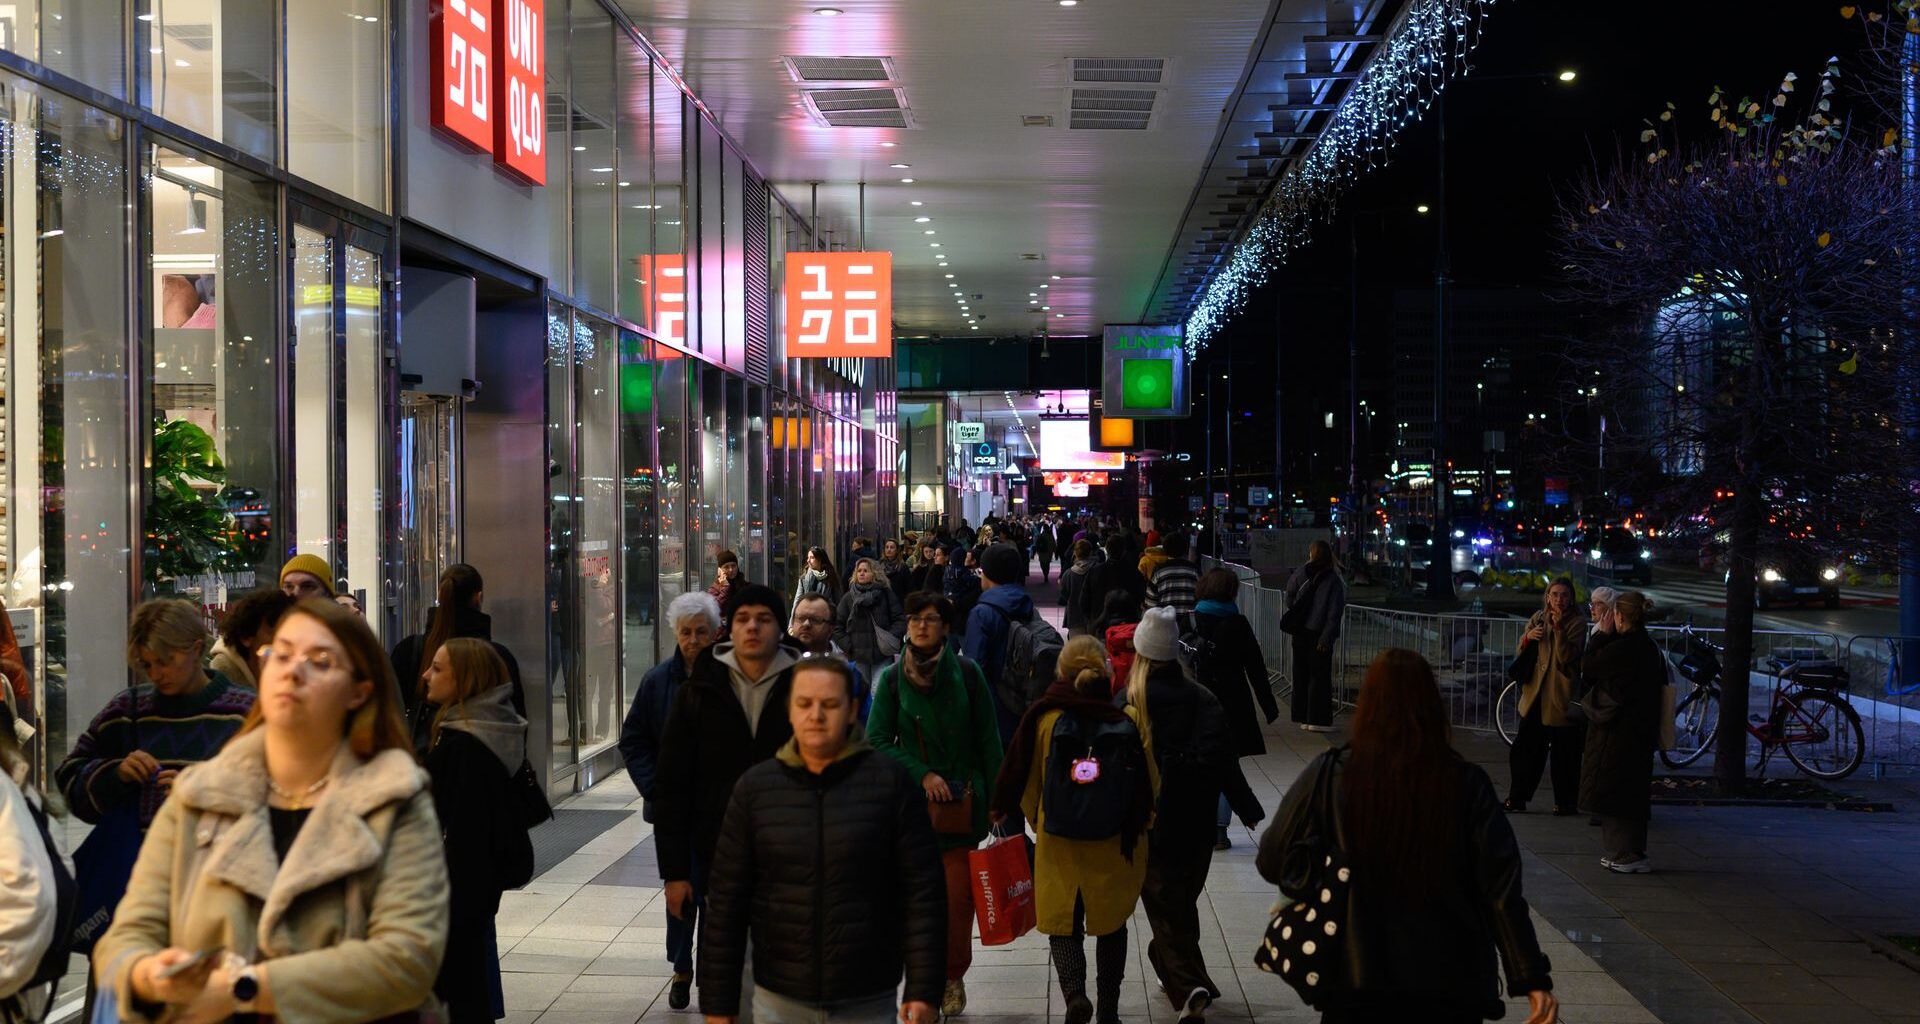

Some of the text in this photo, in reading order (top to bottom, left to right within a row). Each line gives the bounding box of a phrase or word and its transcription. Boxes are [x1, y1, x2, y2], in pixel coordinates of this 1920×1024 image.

[508, 0, 538, 77] UNI
[509, 75, 541, 157] QLO
[1111, 335, 1183, 350] JUNIOR
